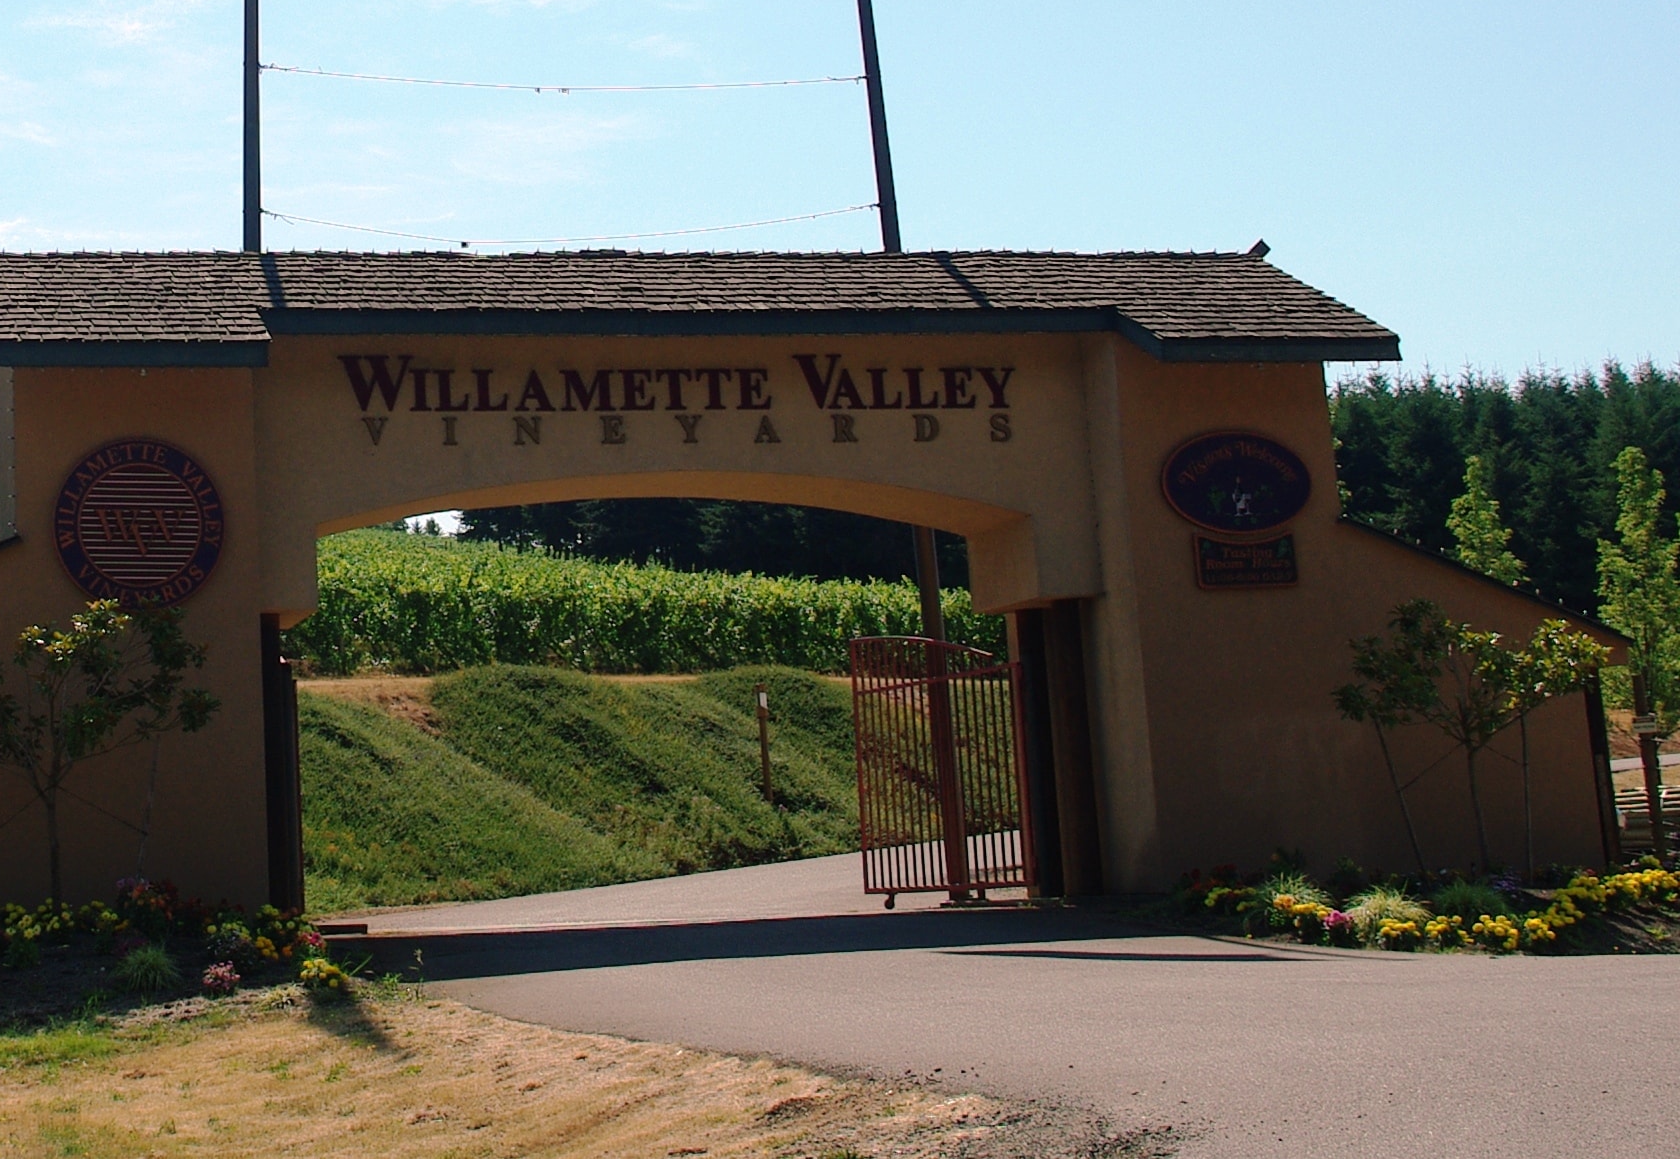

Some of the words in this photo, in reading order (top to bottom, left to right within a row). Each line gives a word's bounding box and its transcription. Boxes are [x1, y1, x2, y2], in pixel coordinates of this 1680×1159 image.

[338, 354, 772, 412] WILLAMETTE
[793, 354, 1015, 410] VALLEY
[361, 414, 1013, 445] VINEYARDS
[58, 444, 168, 548] WILLAMETTE
[181, 460, 221, 548] VALLEY
